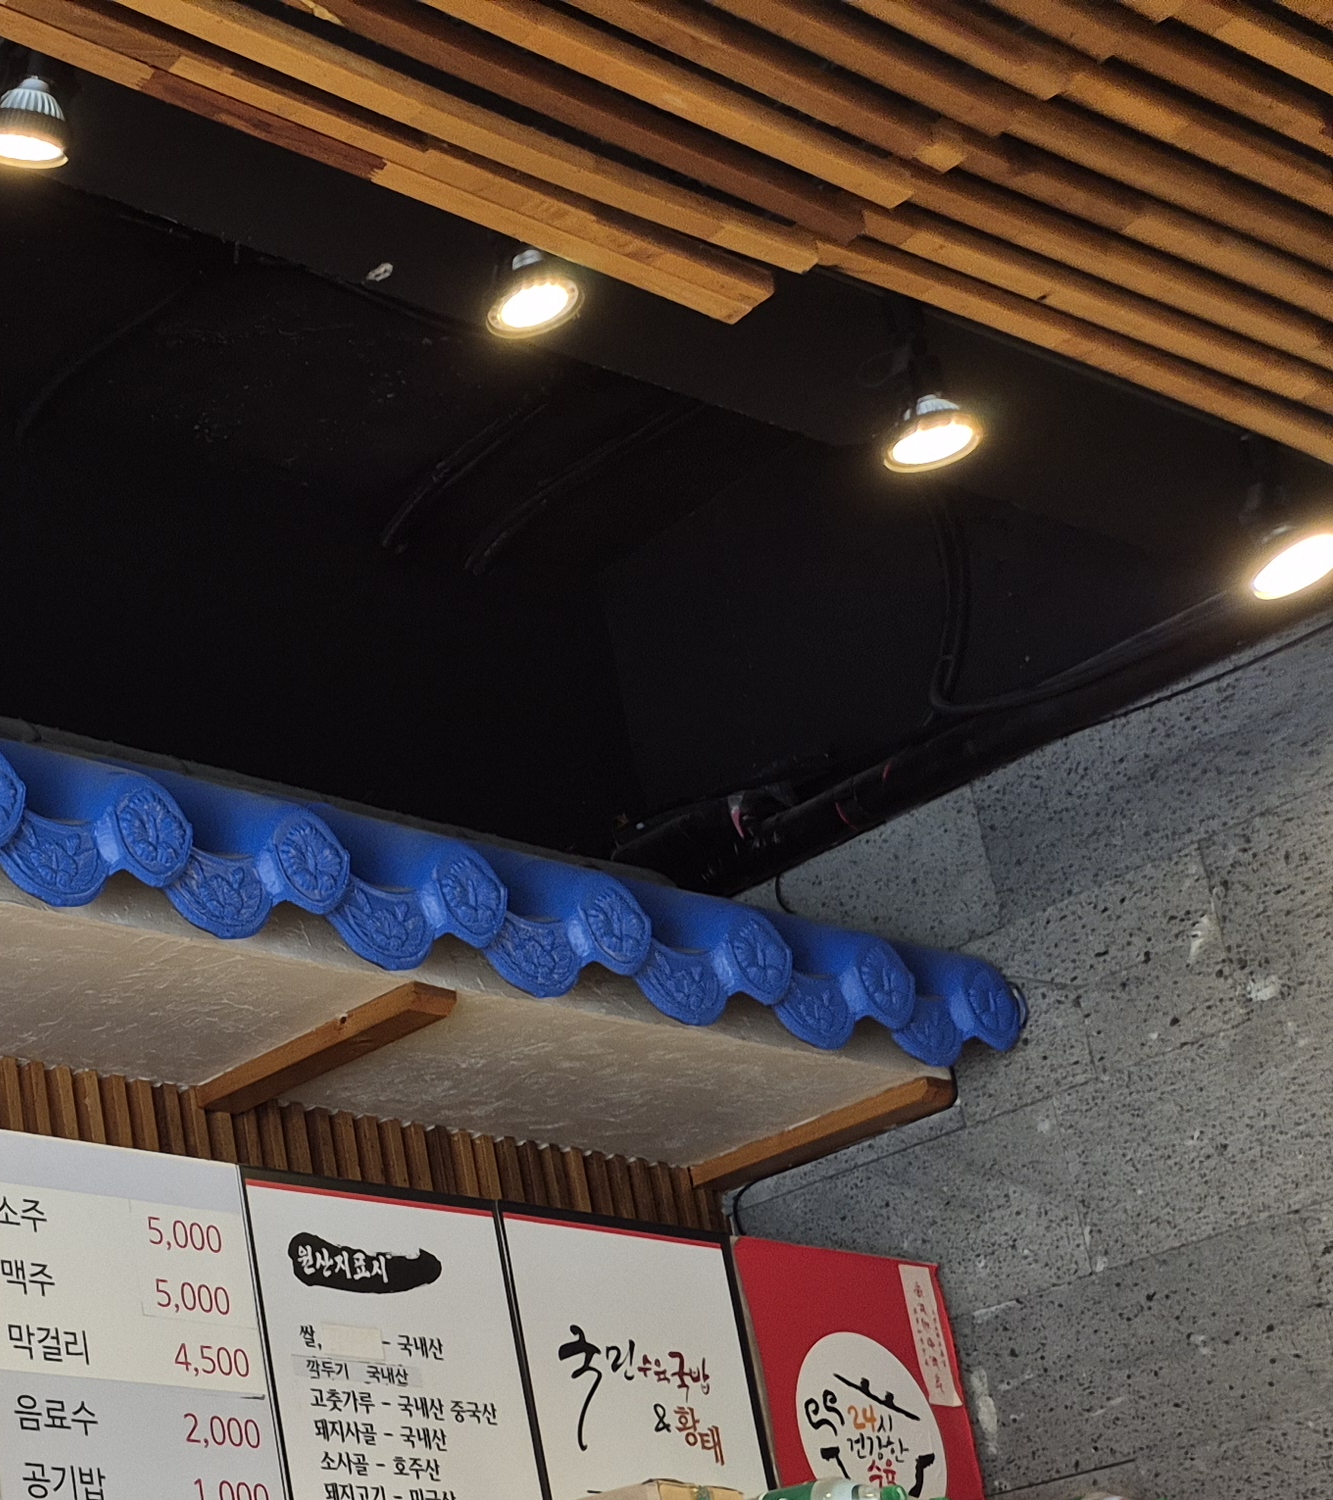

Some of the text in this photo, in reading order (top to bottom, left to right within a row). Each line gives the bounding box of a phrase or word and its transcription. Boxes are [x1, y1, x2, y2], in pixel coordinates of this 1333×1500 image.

[147, 1215, 222, 1254] 5,000
[297, 1245, 392, 1284] 원산지표시
[0, 1259, 230, 1316] 맥주 5,000
[8, 1323, 250, 1378] 막걸리 4,500
[398, 1335, 444, 1361] 국내산
[306, 1359, 408, 1387] 깍두기 국내산
[15, 1394, 261, 1450] 음료수 2,000
[310, 1388, 375, 1414] 고춧가루
[398, 1395, 445, 1421] 국내산
[450, 1400, 498, 1425] 중국산
[847, 1405, 892, 1432] 24시
[314, 1419, 377, 1446] 돼지사골
[400, 1426, 447, 1451] 국내산
[674, 1406, 725, 1466] 황태
[847, 1433, 909, 1462] 건강한
[321, 1451, 369, 1476] 소사골
[393, 1456, 441, 1481] 호주산
